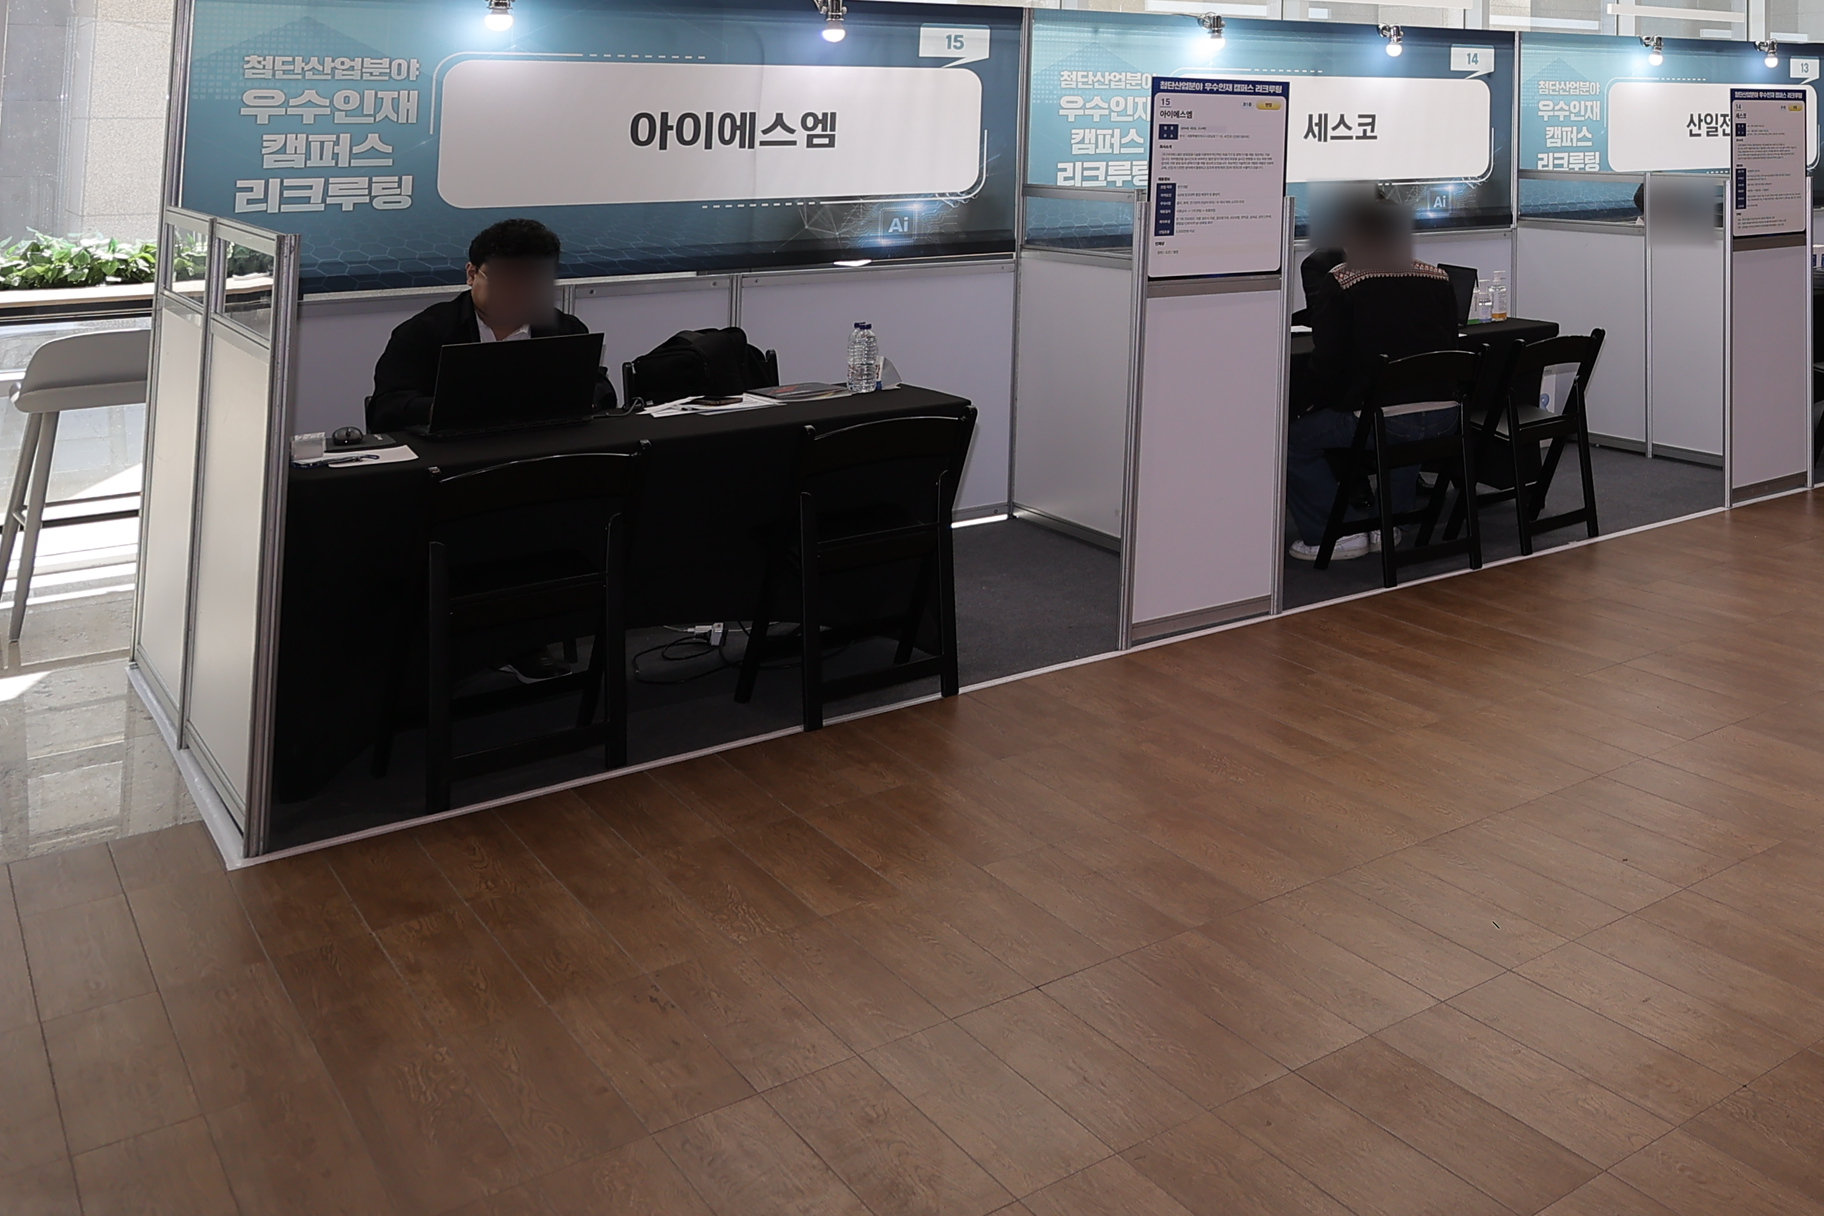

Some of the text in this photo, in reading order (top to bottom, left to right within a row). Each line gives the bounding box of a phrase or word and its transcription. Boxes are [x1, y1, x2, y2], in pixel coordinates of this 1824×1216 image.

[945, 34, 965, 51] 15
[243, 54, 420, 82] 첨단산업분야
[1466, 52, 1479, 65] 14
[1800, 63, 1809, 73] 13
[1538, 80, 1600, 95] 첨단산업분야
[240, 88, 419, 126] 우수인재
[1059, 95, 1151, 122] 우수인재
[1161, 98, 1171, 106] 15
[1538, 100, 1600, 121] 우수인재
[1159, 110, 1193, 119] 아이에스엠
[1686, 113, 1731, 137] 산일전
[628, 110, 838, 151] 아이에스엠
[1303, 113, 1378, 144] 세스코
[1545, 126, 1592, 147] 캠퍼스
[262, 131, 394, 171] 캠퍼스
[1071, 128, 1145, 155] 캠퍼스
[1537, 151, 1600, 172] 리크루팅
[234, 176, 414, 215] 리크루팅
